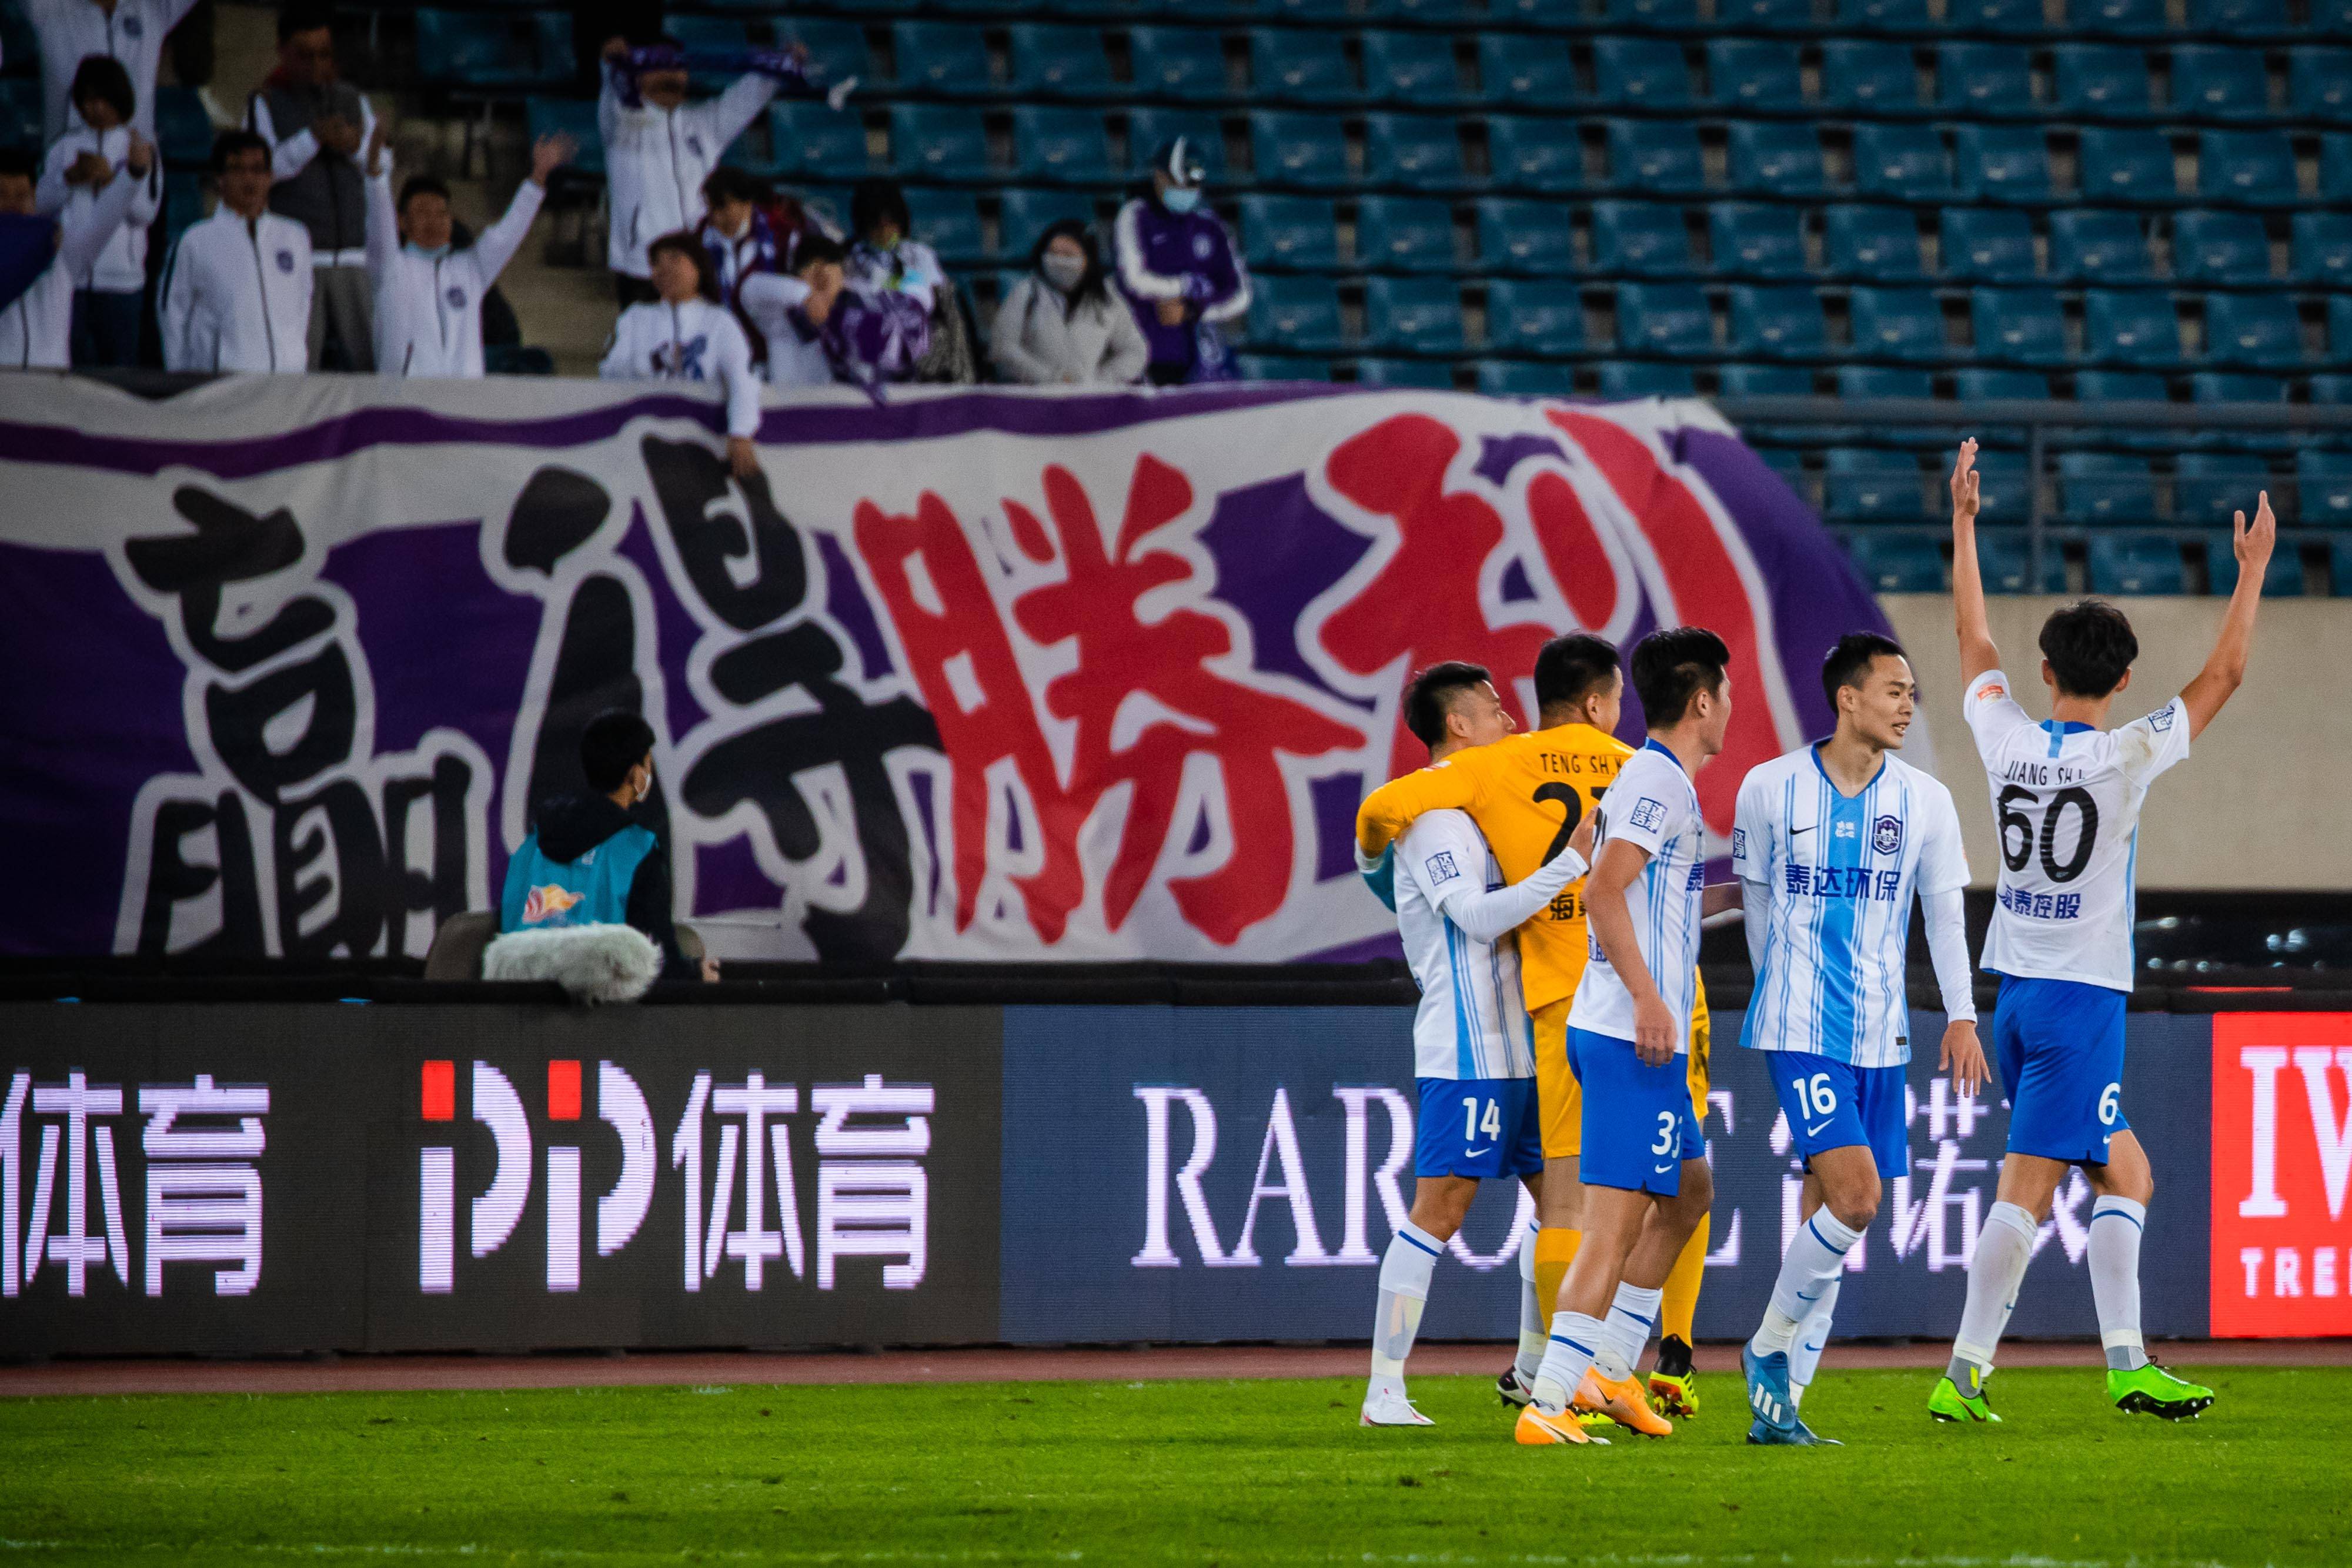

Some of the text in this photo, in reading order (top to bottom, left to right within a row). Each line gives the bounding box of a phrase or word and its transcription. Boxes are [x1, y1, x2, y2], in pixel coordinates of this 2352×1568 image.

[1540, 754, 1581, 773] TENG
[2004, 760, 2047, 785] JIANG
[1533, 781, 1608, 875] 2
[1999, 785, 2098, 882] 60
[1785, 864, 1901, 901] 泰达环保
[1549, 893, 1587, 921] 海
[1462, 1097, 1501, 1141] 14
[1793, 1073, 1836, 1120] 16
[0, 1067, 269, 1297] 体育
[2240, 1246, 2352, 1298] TRE
